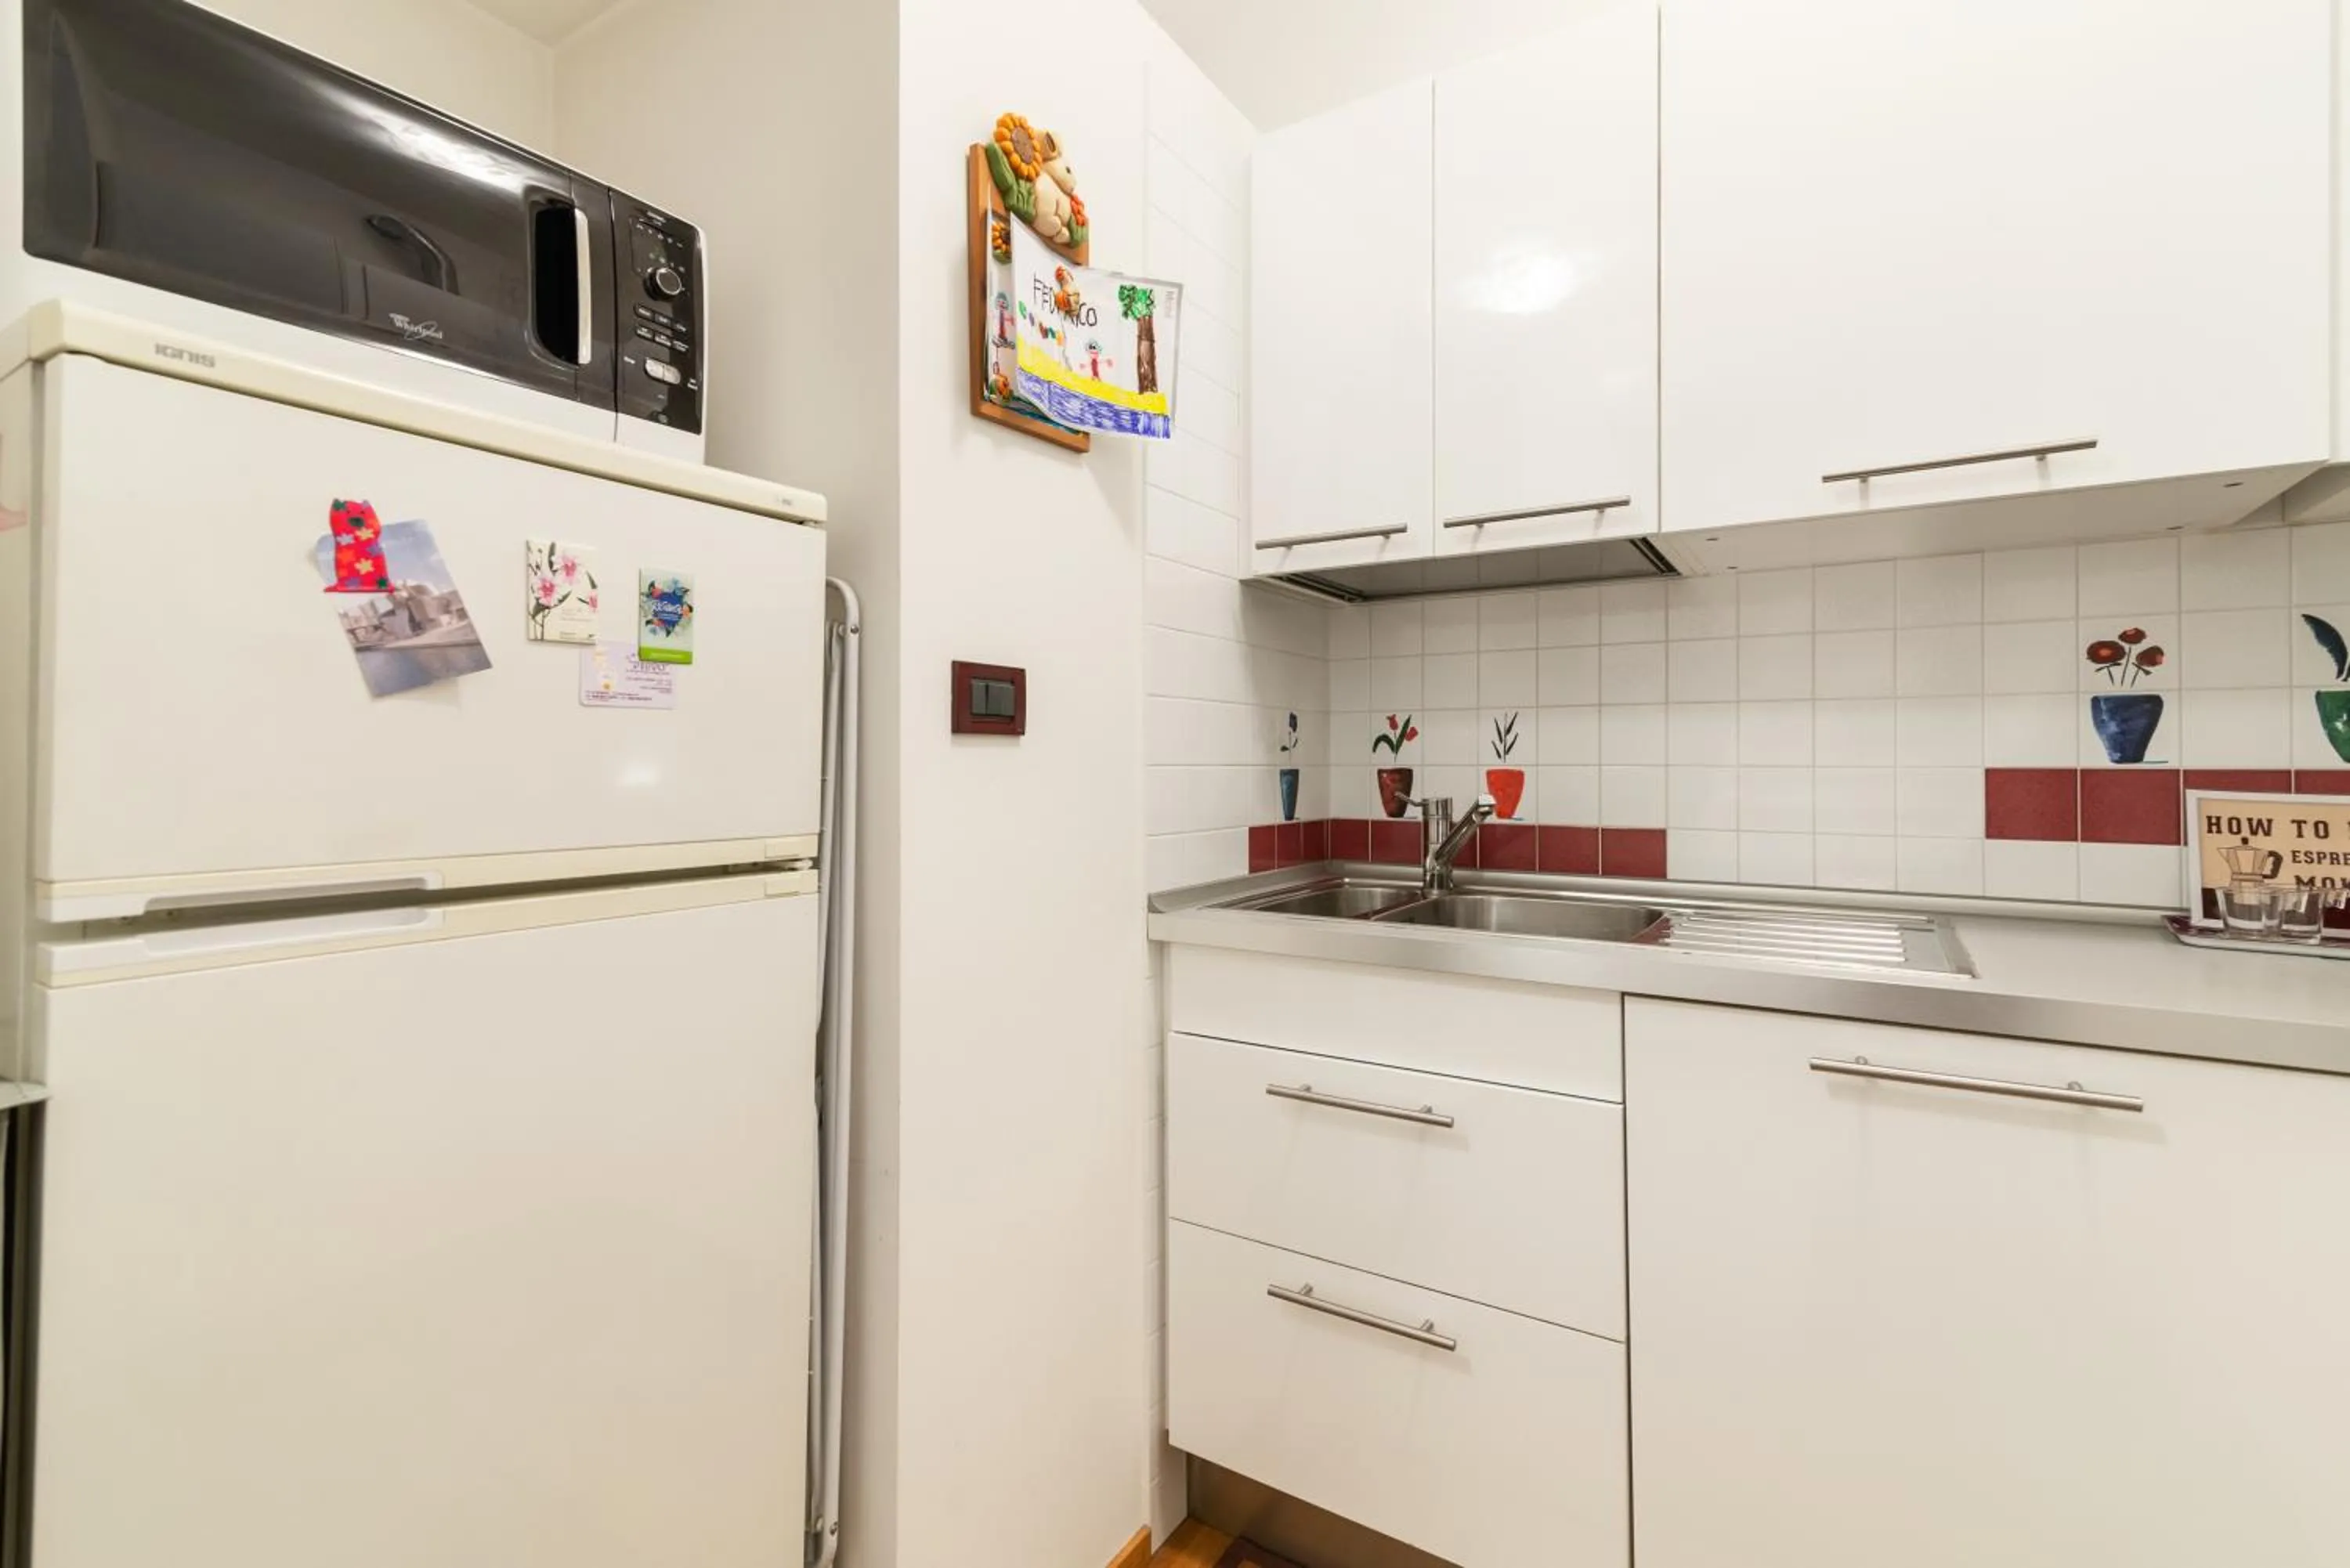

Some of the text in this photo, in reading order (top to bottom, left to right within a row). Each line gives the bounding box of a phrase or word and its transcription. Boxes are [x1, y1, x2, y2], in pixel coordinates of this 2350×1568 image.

[389, 313, 443, 341] Whirlpool
[2206, 815, 2273, 836] HOW
[2290, 819, 2330, 840] TO
[2290, 850, 2350, 865] ESPRE
